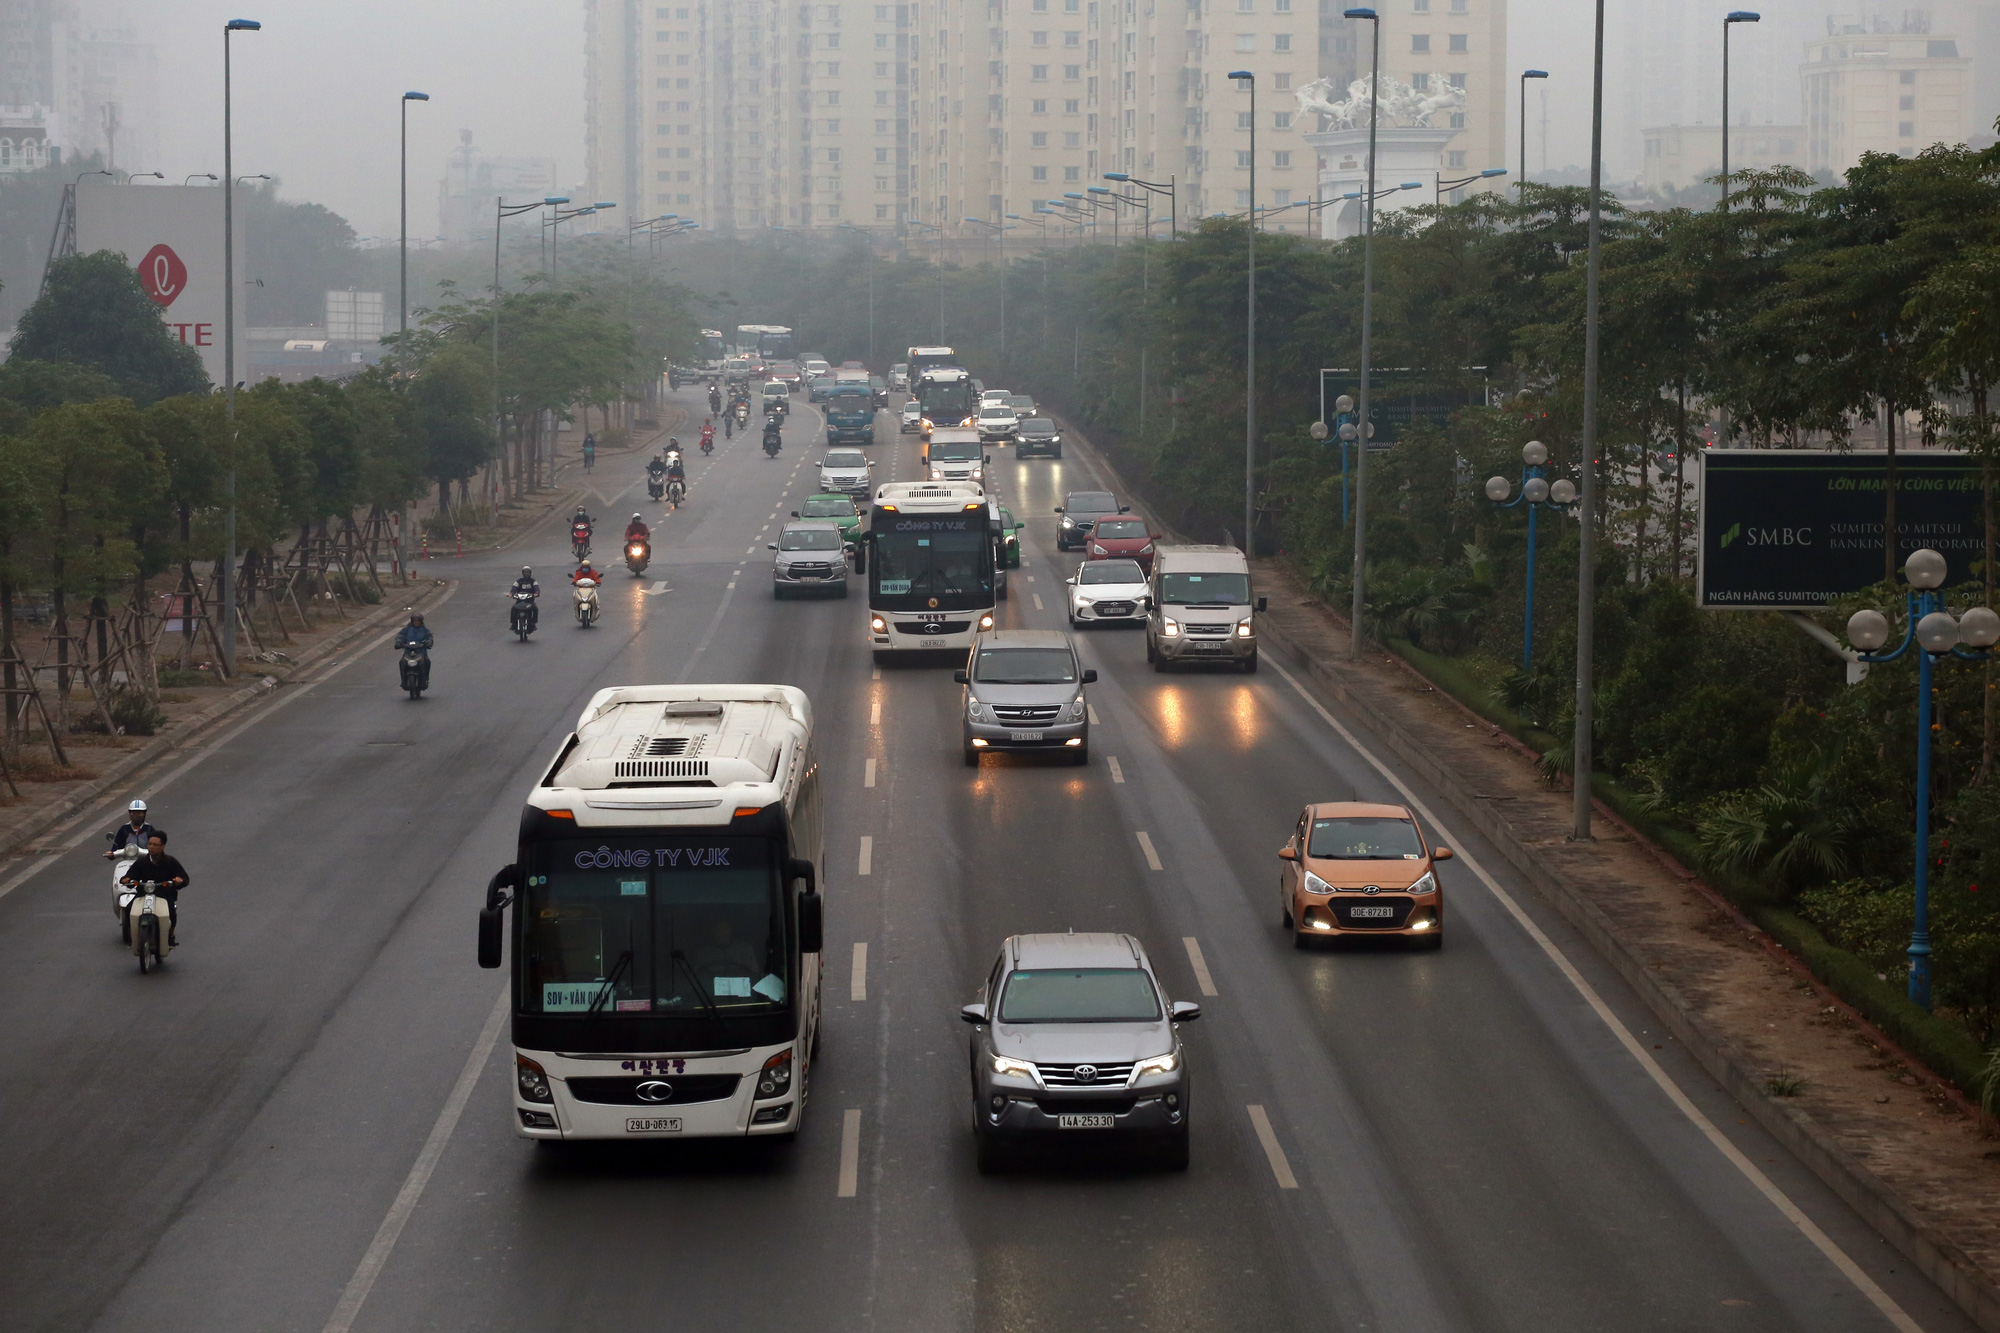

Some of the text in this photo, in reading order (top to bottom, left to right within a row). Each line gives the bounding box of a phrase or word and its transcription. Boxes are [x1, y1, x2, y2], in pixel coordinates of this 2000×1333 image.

[1828, 476, 1857, 491] LỚN
[1904, 476, 1944, 491] CÙNG
[895, 520, 966, 531] CÔNG TY VJK
[1830, 523, 1961, 534] SUMITOO MITSUI
[1747, 527, 1812, 546] SMBC
[1830, 538, 1890, 549] BANKIN
[1709, 589, 1741, 601] NGÂN
[1743, 589, 1775, 601] HÀNG
[1777, 591, 1838, 601] SUMITOMO
[574, 845, 730, 869] CÔNG TY VJK
[546, 991, 563, 1006] SDV
[570, 989, 586, 1005] VĂN
